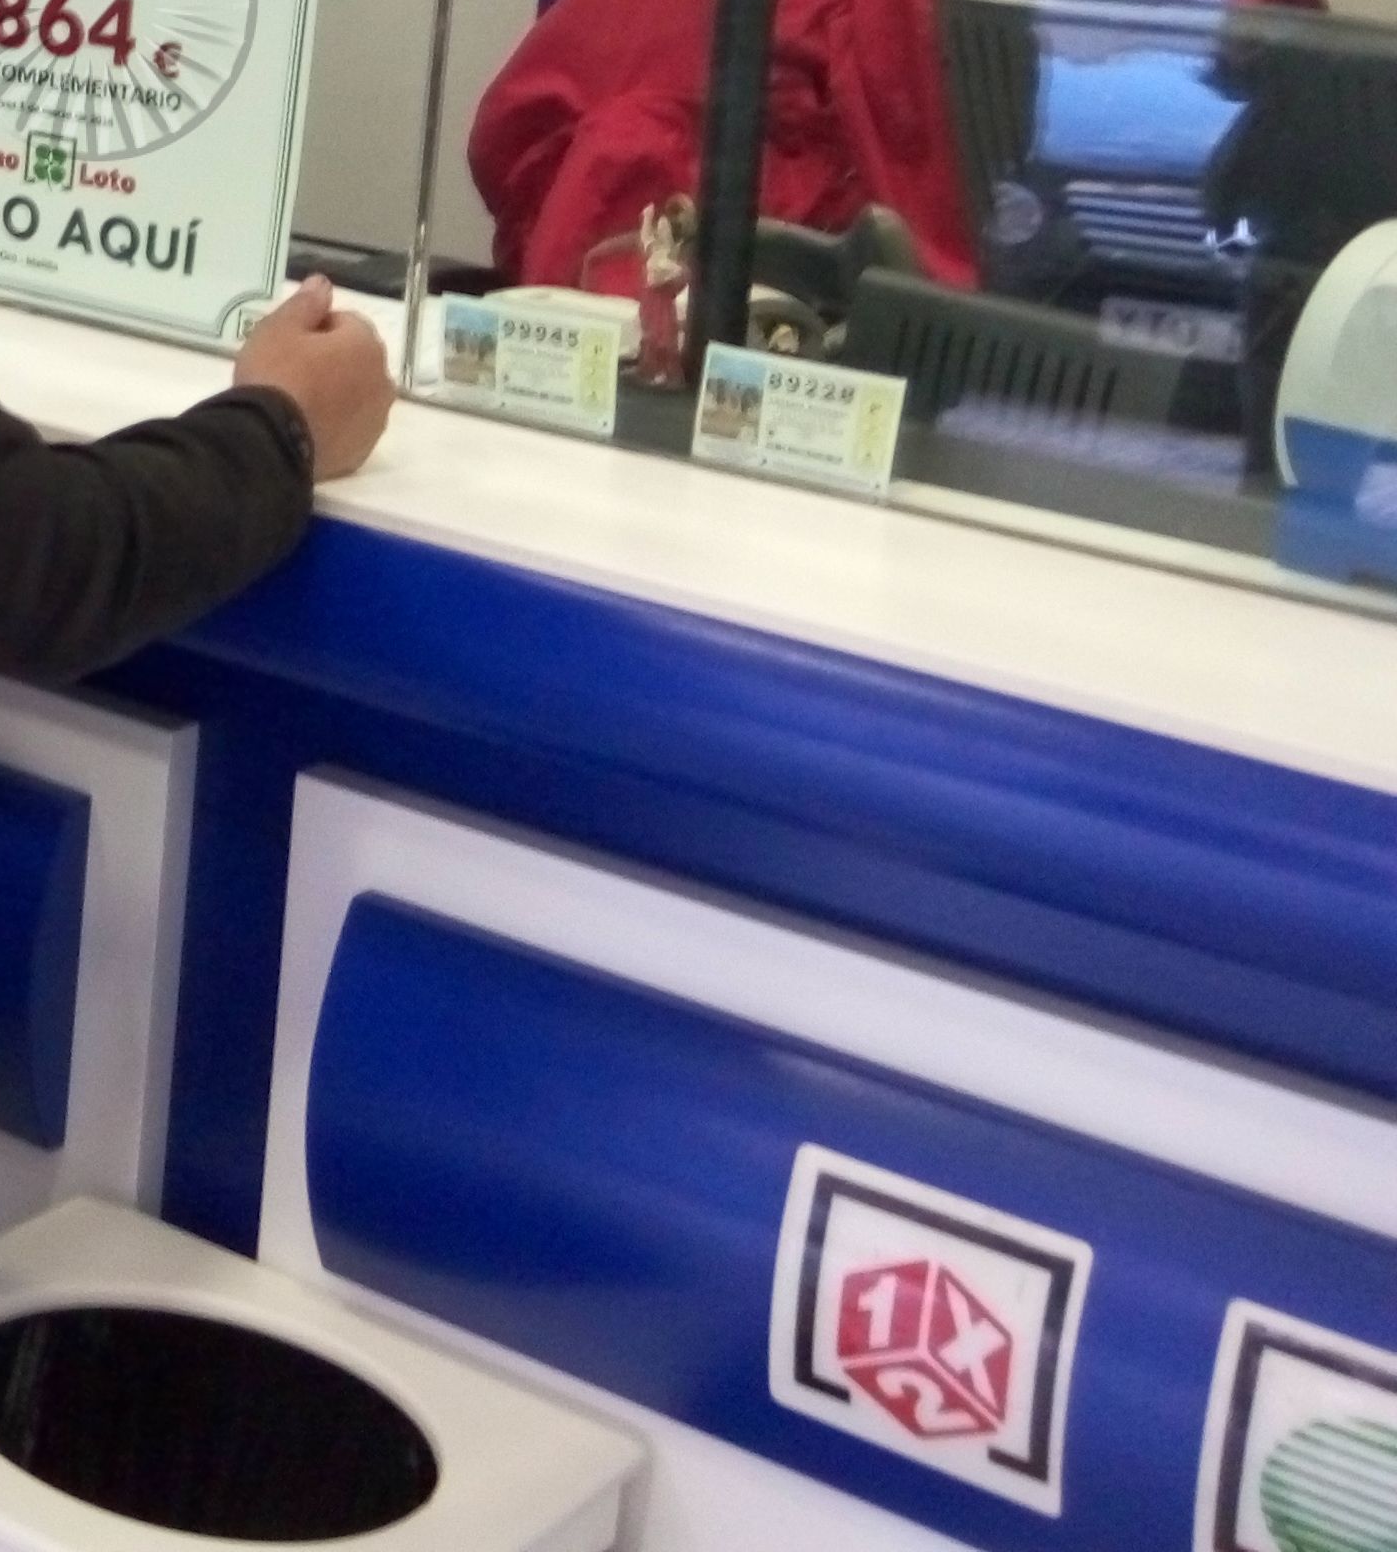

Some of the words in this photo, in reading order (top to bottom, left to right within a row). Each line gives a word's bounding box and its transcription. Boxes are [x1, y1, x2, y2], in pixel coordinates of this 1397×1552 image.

[154, 42, 184, 79] €
[79, 164, 137, 195] Loto
[58, 208, 203, 276] AQUÍ
